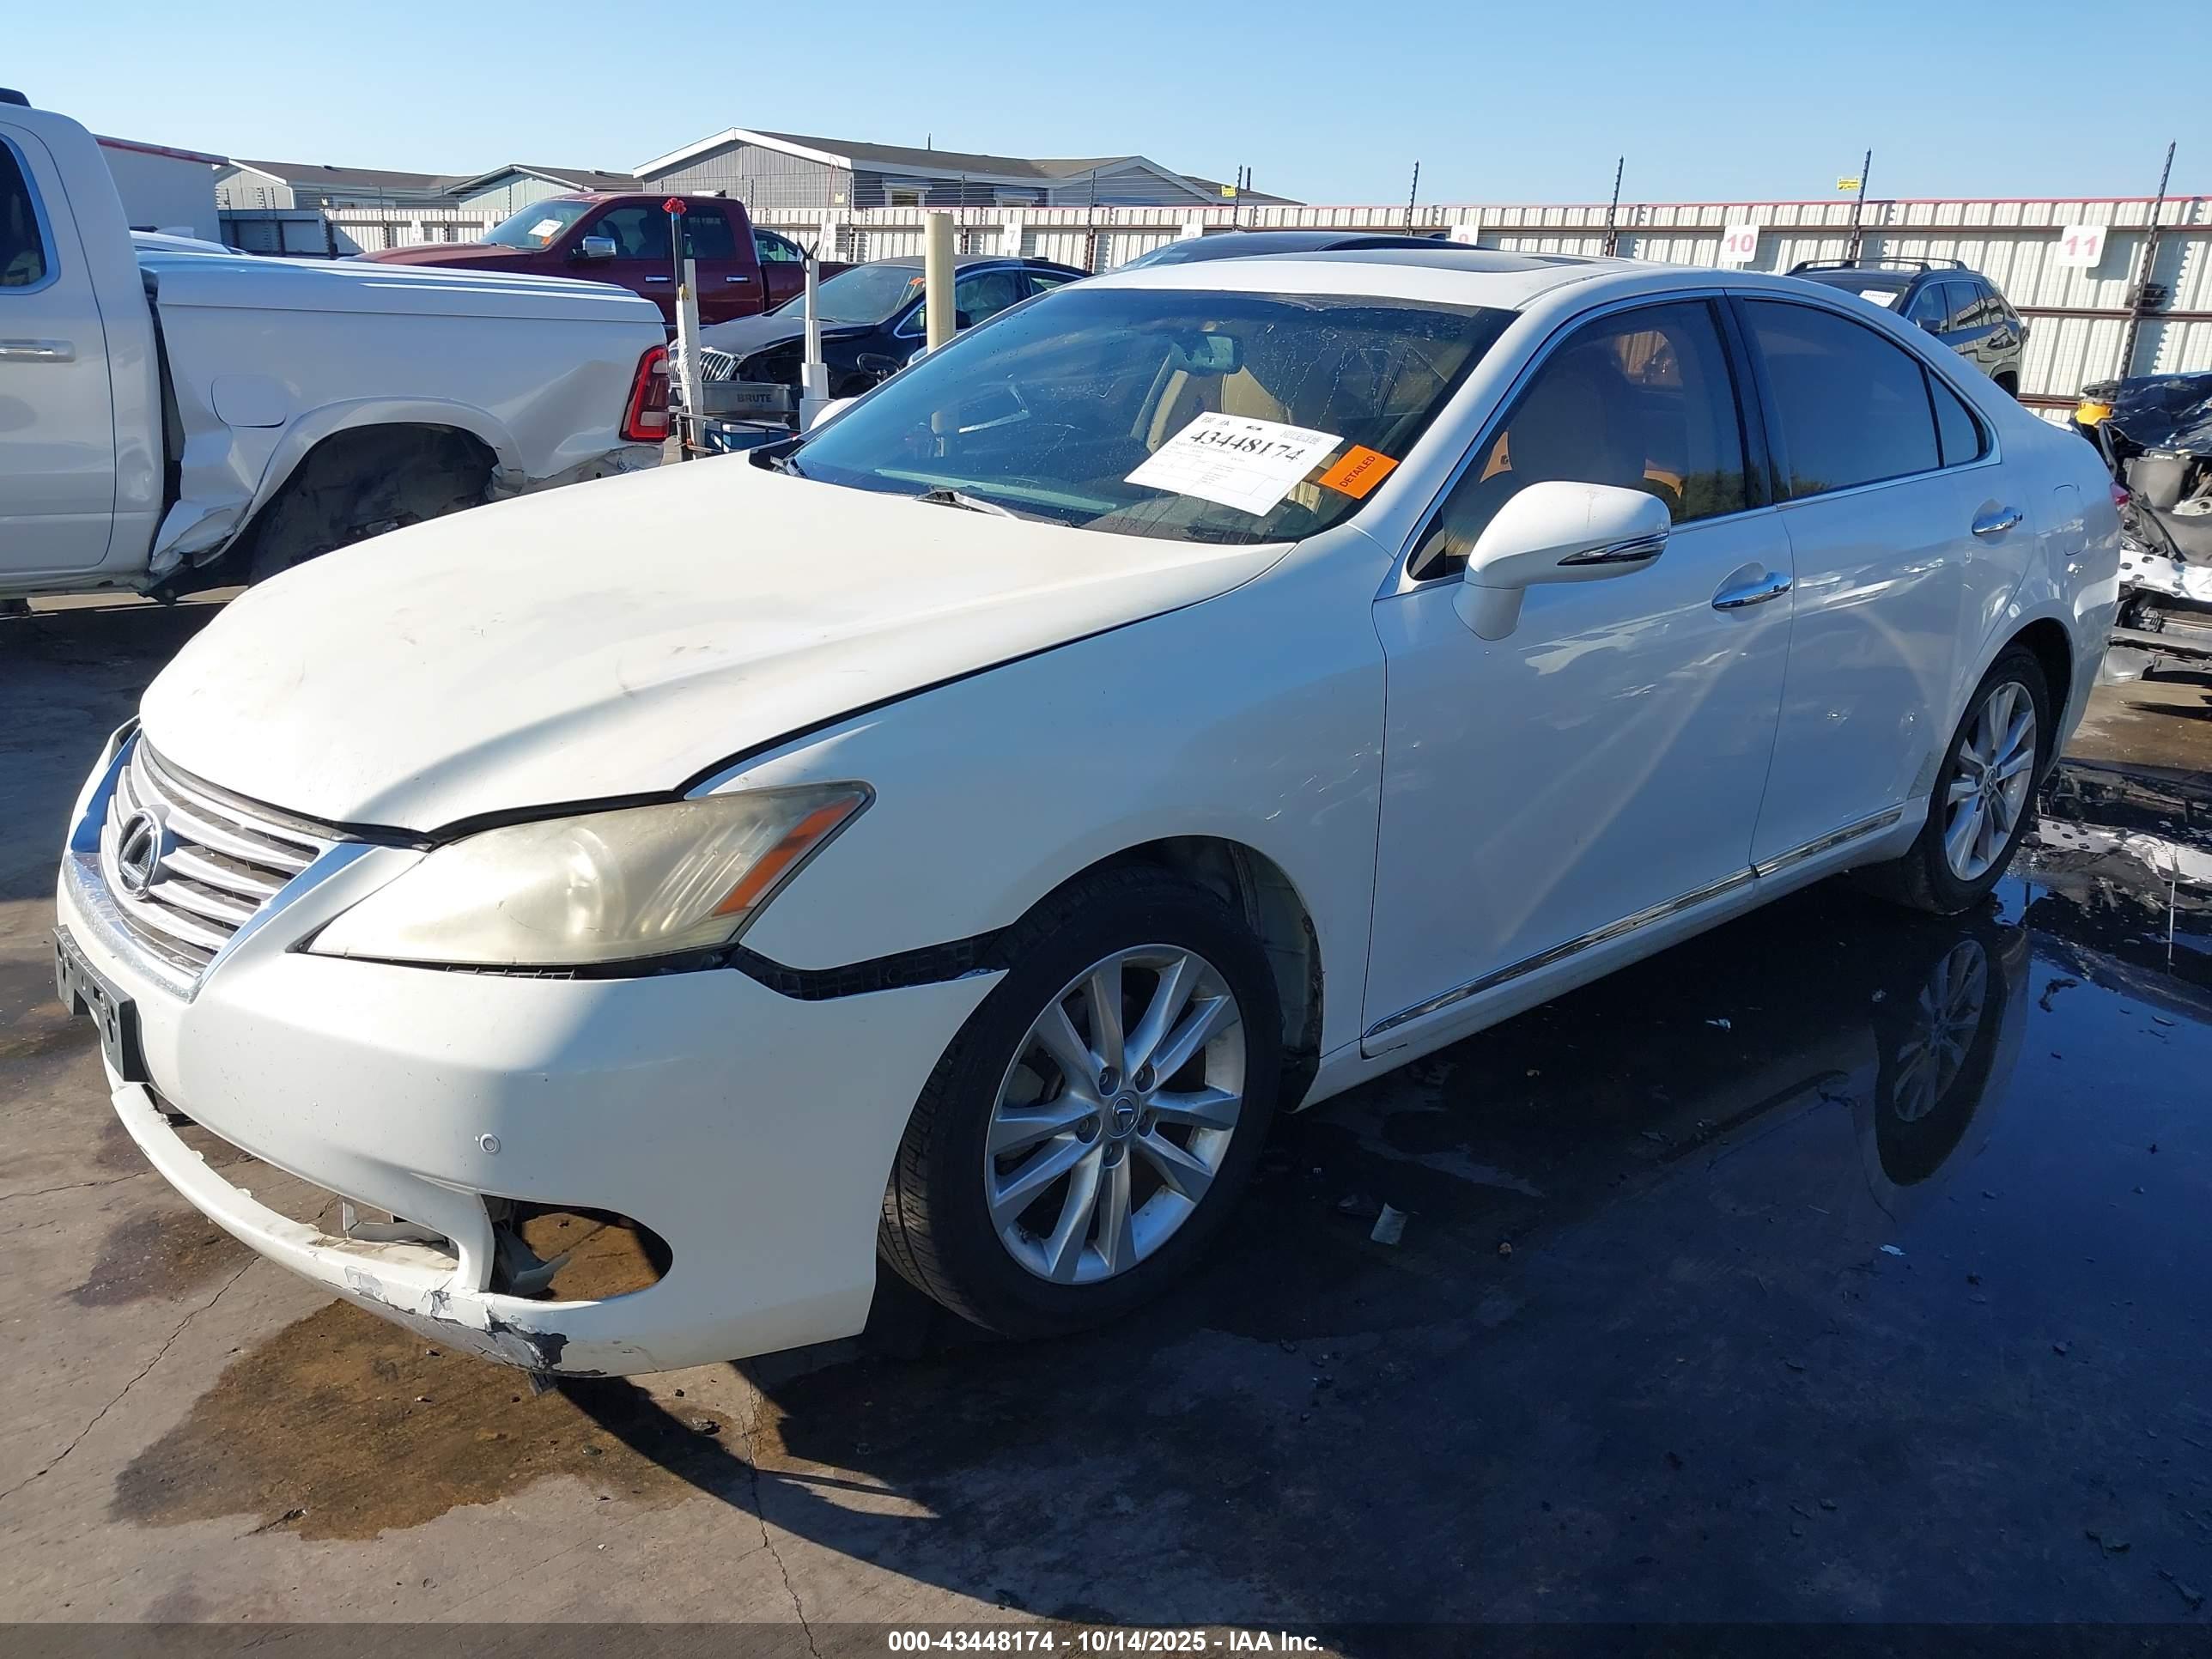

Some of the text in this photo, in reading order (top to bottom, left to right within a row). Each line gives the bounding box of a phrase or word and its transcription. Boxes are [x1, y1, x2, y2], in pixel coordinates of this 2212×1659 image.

[1009, 230, 1016, 243] 7
[1726, 234, 1754, 252] 10
[2065, 235, 2097, 256] 11
[737, 393, 773, 403] BRUTE
[1190, 430, 1306, 461] 43448174
[1340, 456, 1376, 487] DETAILED
